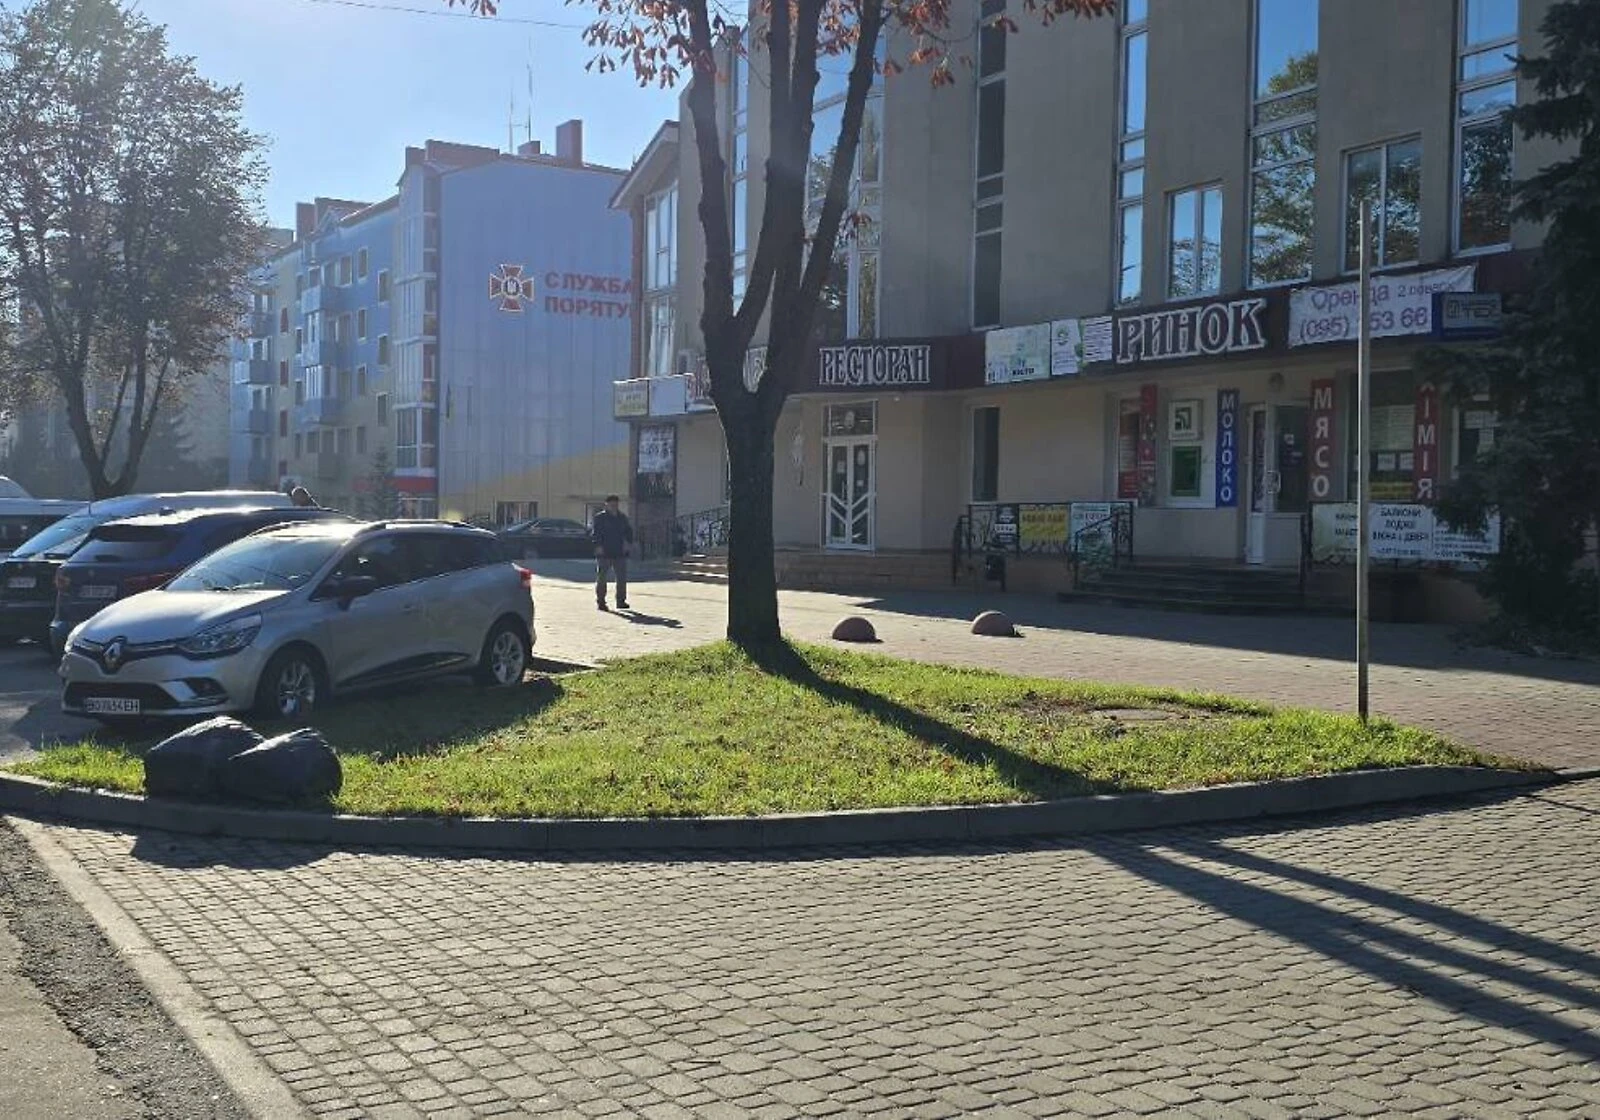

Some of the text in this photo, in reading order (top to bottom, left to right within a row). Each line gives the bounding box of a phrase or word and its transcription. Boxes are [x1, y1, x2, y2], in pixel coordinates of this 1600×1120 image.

[545, 296, 632, 319] ПОРЯТУ
[1116, 298, 1267, 363] РИНОК
[819, 345, 931, 384] РЕСТОРАН
[1219, 393, 1235, 502] МОЛОКО
[1312, 387, 1332, 498] МЯСО
